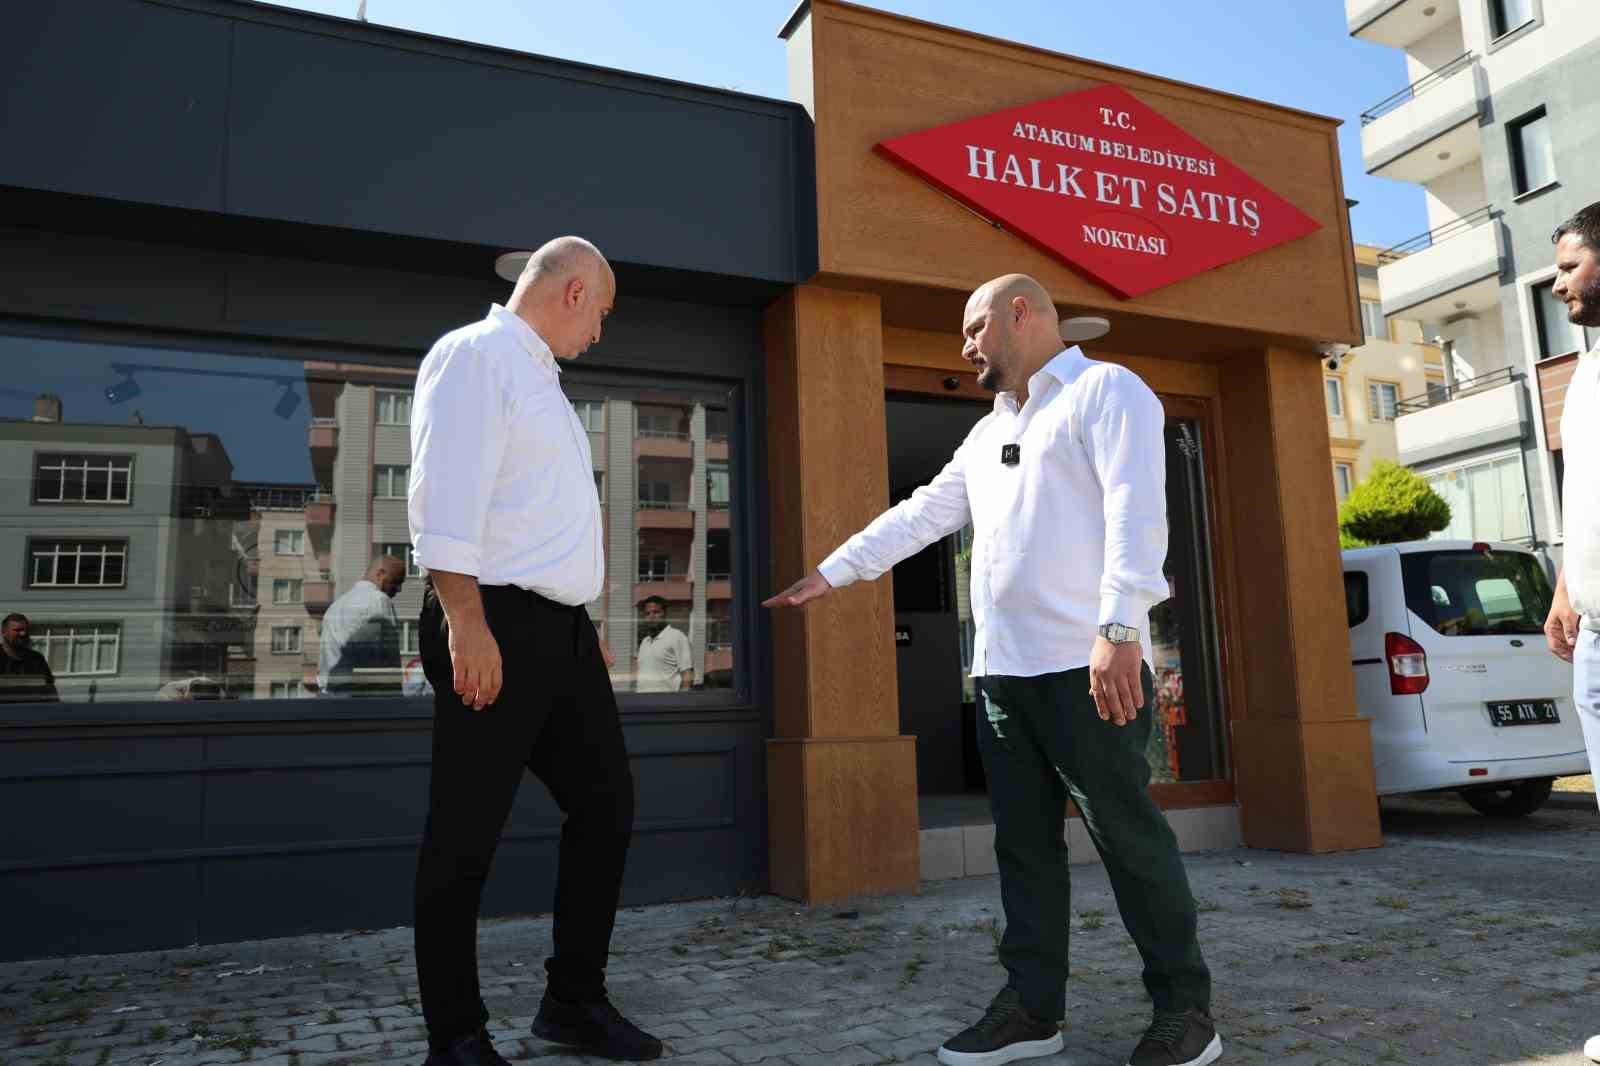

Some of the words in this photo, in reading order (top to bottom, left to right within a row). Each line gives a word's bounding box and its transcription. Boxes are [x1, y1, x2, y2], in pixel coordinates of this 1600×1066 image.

[1099, 107, 1137, 132] T.C.
[1013, 121, 1096, 153] ATAKUM
[1099, 137, 1217, 178] BELEDİYESİ
[965, 145, 1088, 200] HALK
[1094, 171, 1147, 210] ET
[1157, 183, 1262, 237] SATIŞ
[1082, 224, 1167, 257] NOKTASI
[1498, 704, 1513, 720] 55
